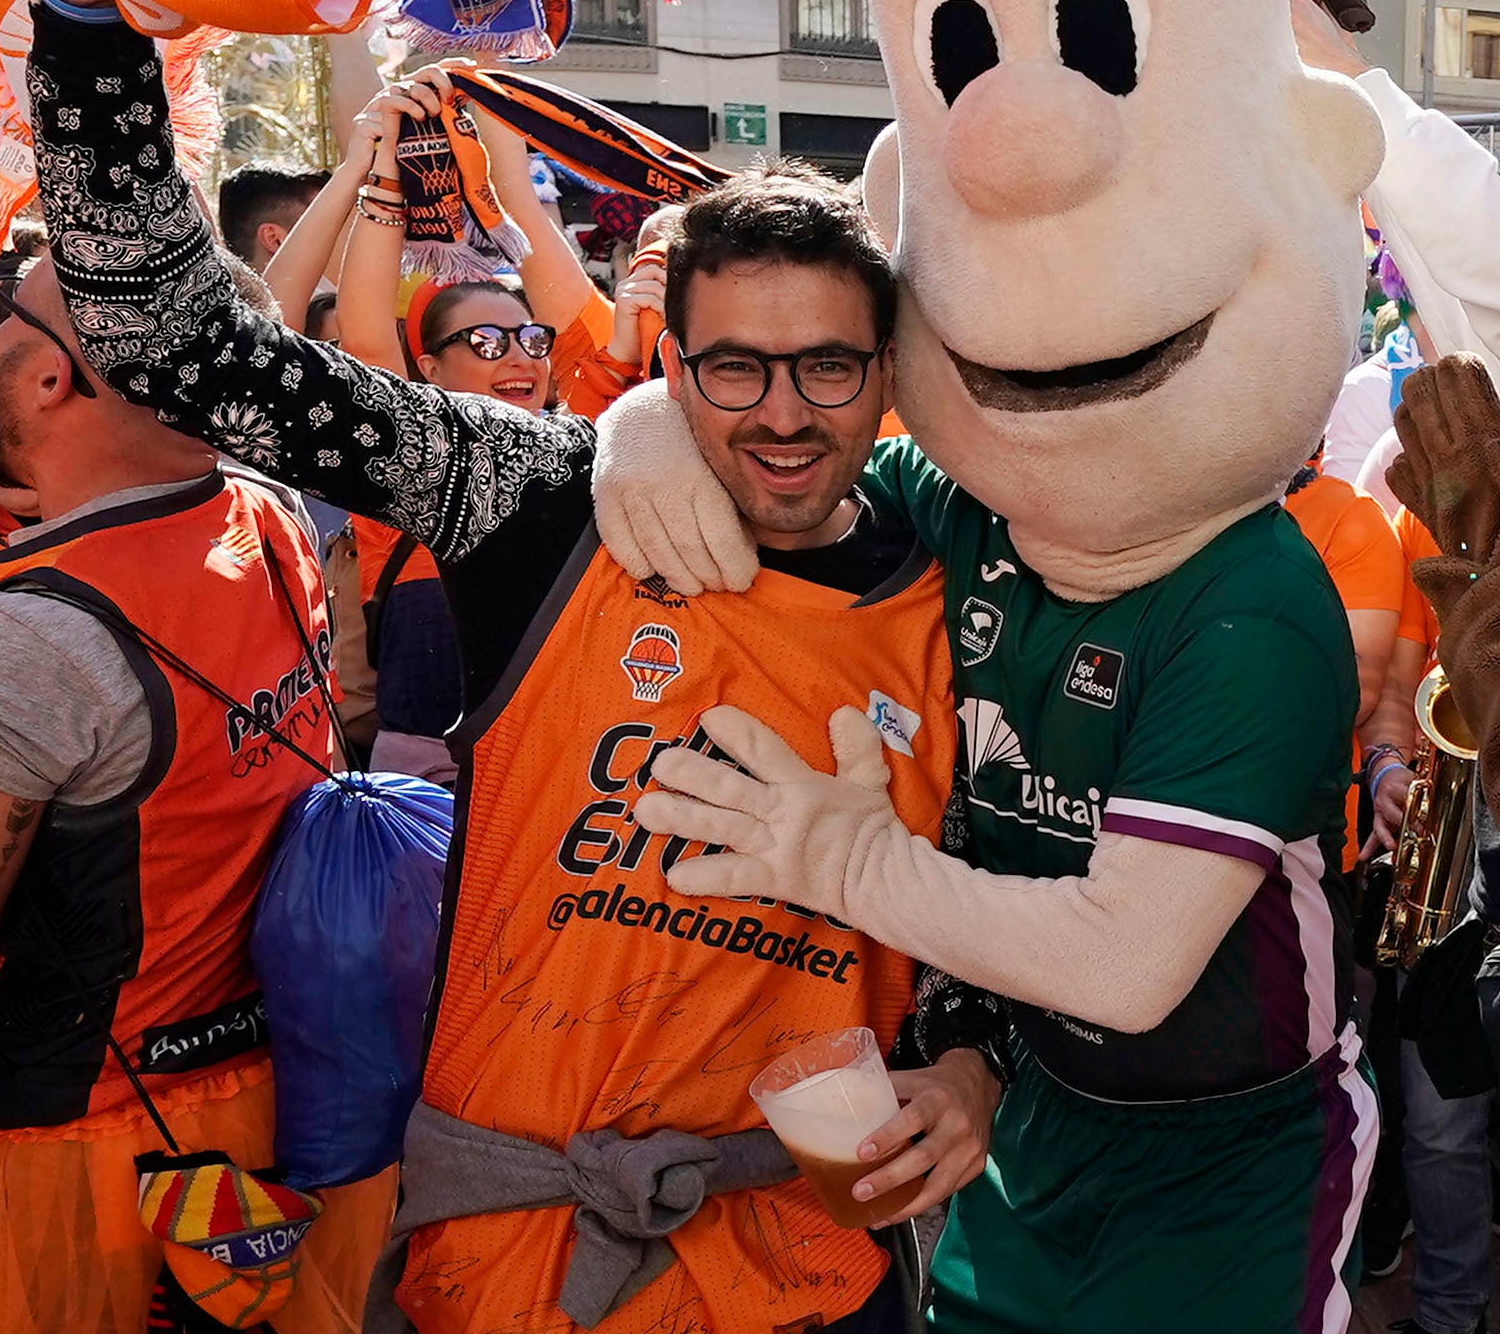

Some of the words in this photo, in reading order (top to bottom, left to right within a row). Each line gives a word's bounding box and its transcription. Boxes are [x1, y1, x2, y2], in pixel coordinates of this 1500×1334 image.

[226, 628, 333, 756] PAMEA
[1070, 677, 1114, 702] endesa
[1075, 660, 1096, 679] liga
[1020, 773, 1103, 839] Unicaj
[546, 883, 859, 986] @alenciaBasket
